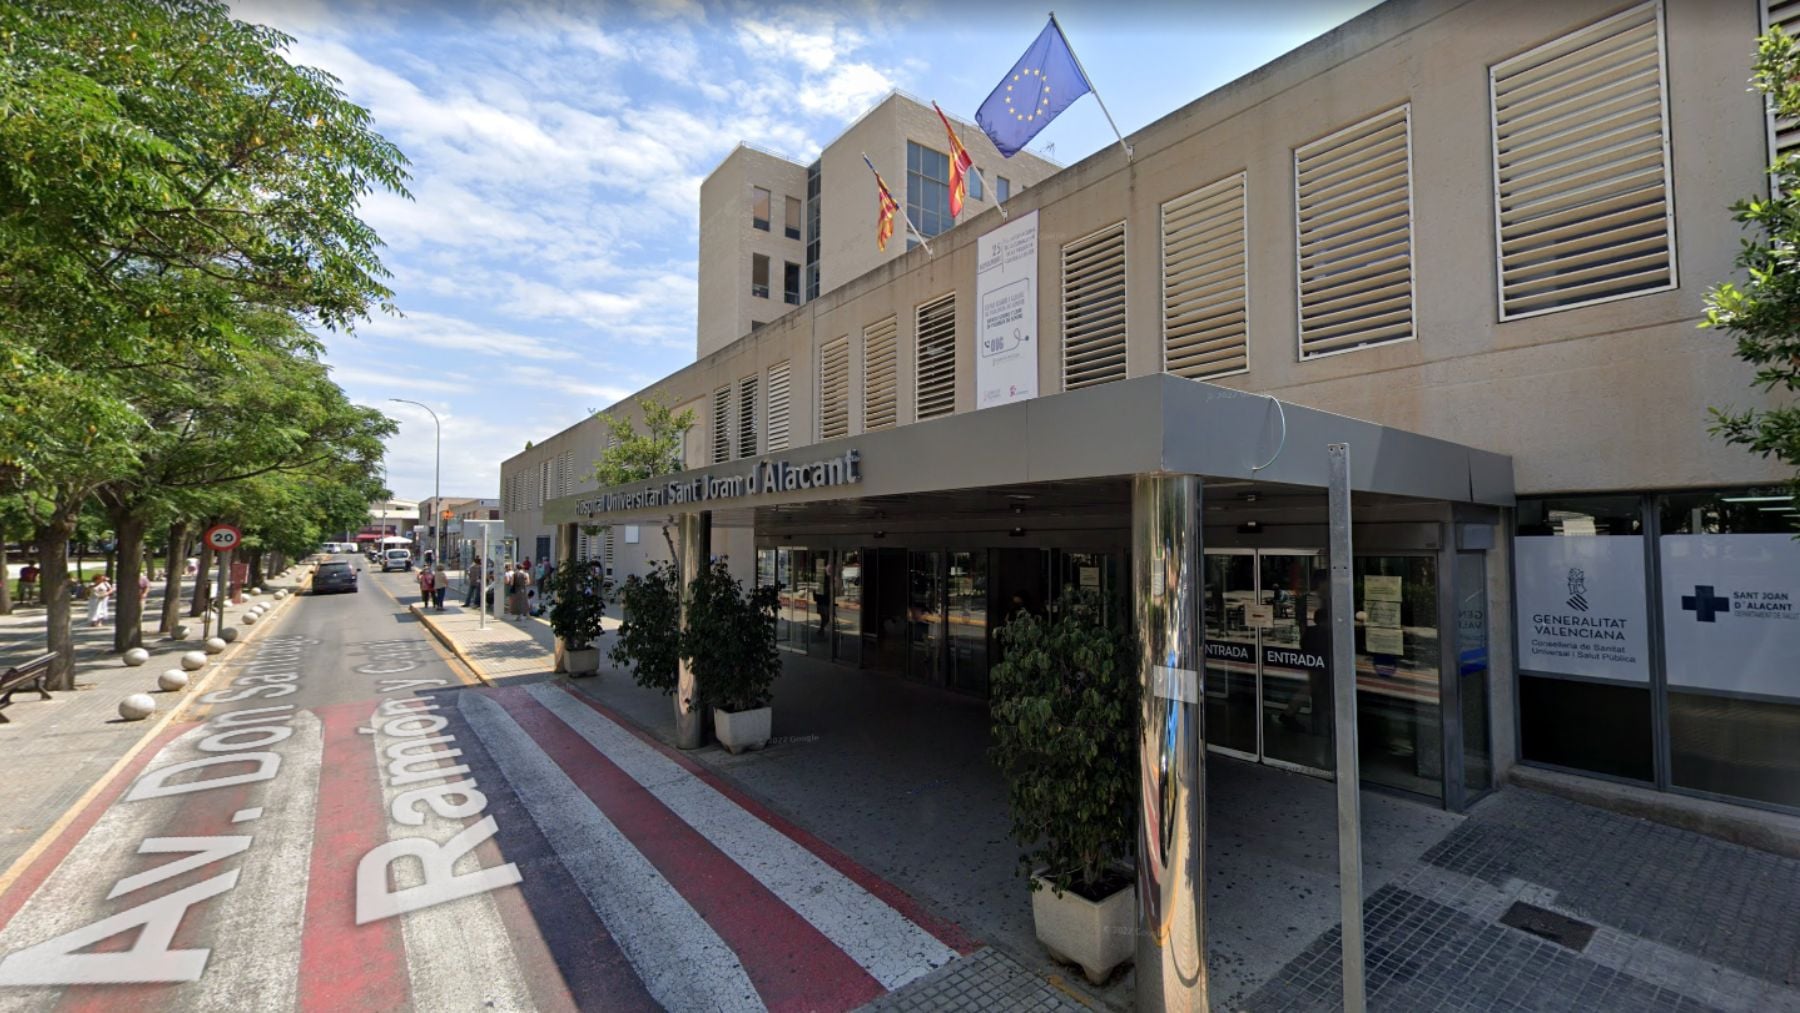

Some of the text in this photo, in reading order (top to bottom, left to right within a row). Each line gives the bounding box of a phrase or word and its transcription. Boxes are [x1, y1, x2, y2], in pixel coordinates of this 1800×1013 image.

[575, 494, 604, 517] Hospital
[606, 487, 664, 512] Universitari
[667, 479, 700, 505] Sant
[703, 474, 742, 500] Joan
[213, 533, 234, 542] 20
[1733, 591, 1789, 601] SANT JOAN
[1532, 613, 1628, 629] GENERALITAT
[1534, 625, 1626, 641] VALENCIANA
[1204, 644, 1249, 659] NTRADA
[1531, 639, 1626, 654] Conselleria de Sanitat
[1531, 647, 1570, 657] Universal
[1577, 651, 1601, 660] Salut
[1267, 650, 1325, 668] ENTRADA
